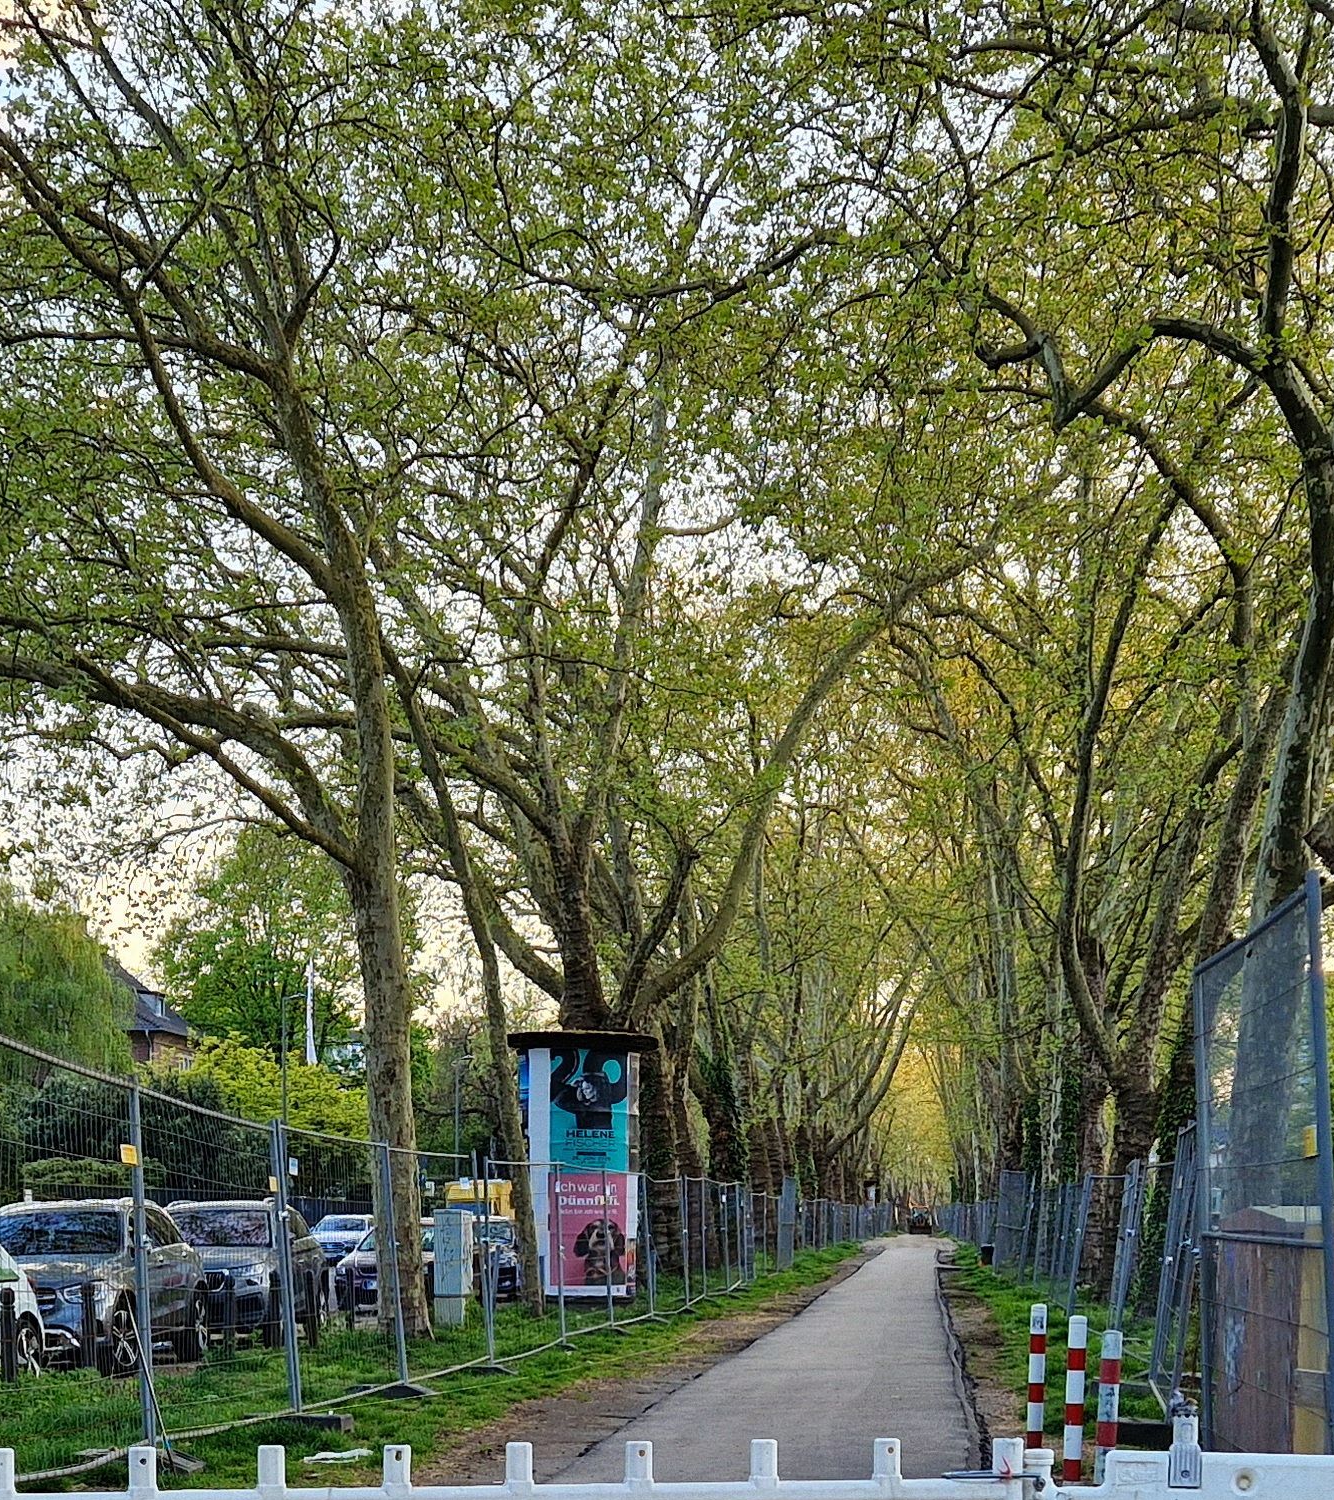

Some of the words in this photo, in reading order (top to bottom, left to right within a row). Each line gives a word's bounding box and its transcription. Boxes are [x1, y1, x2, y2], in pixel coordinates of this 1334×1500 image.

[566, 1129, 616, 1138] HELENE
[565, 1138, 616, 1148] FISCHER
[577, 1183, 601, 1192] war
